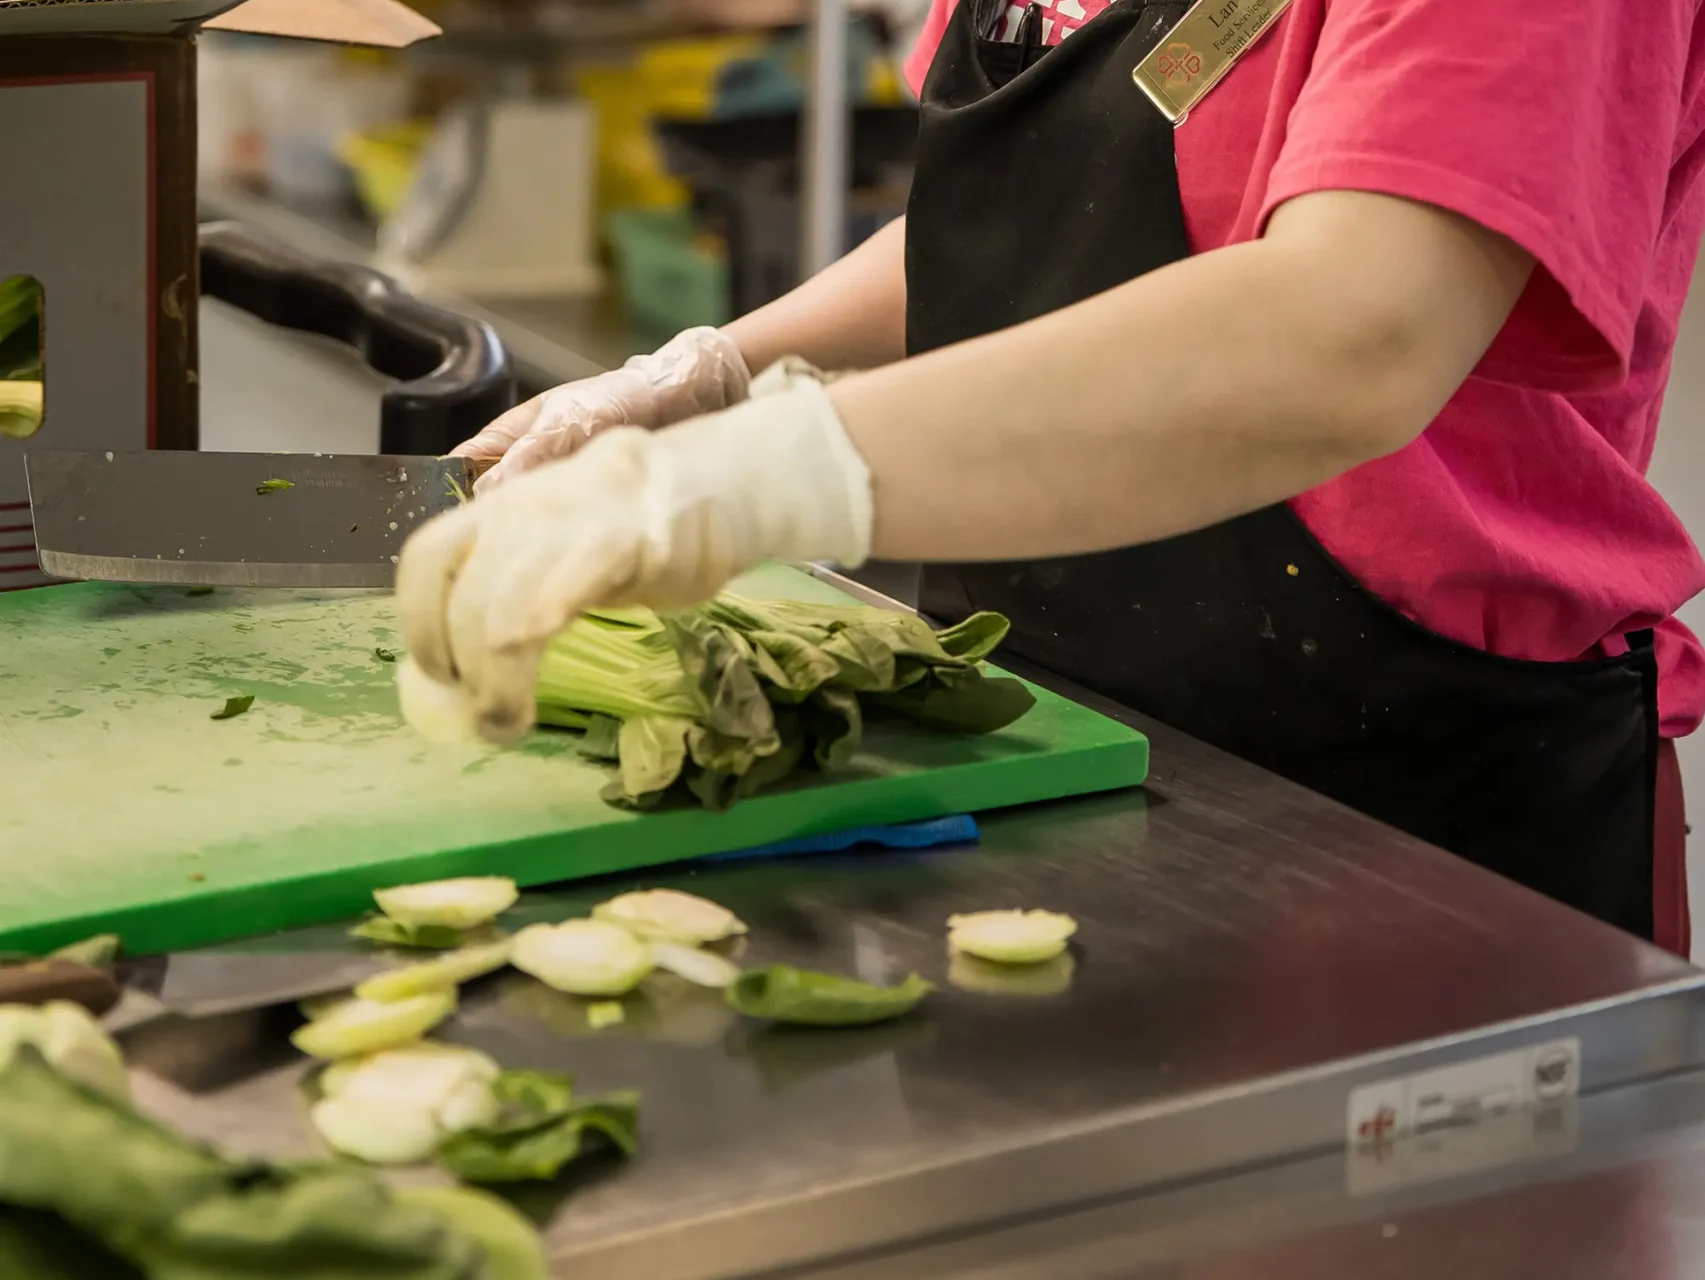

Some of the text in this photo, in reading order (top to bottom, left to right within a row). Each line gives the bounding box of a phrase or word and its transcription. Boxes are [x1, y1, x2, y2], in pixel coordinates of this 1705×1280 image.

[1207, 0, 1239, 29] Lan
[1213, 27, 1235, 51] Food
[1225, 9, 1272, 58] Shift Leader
